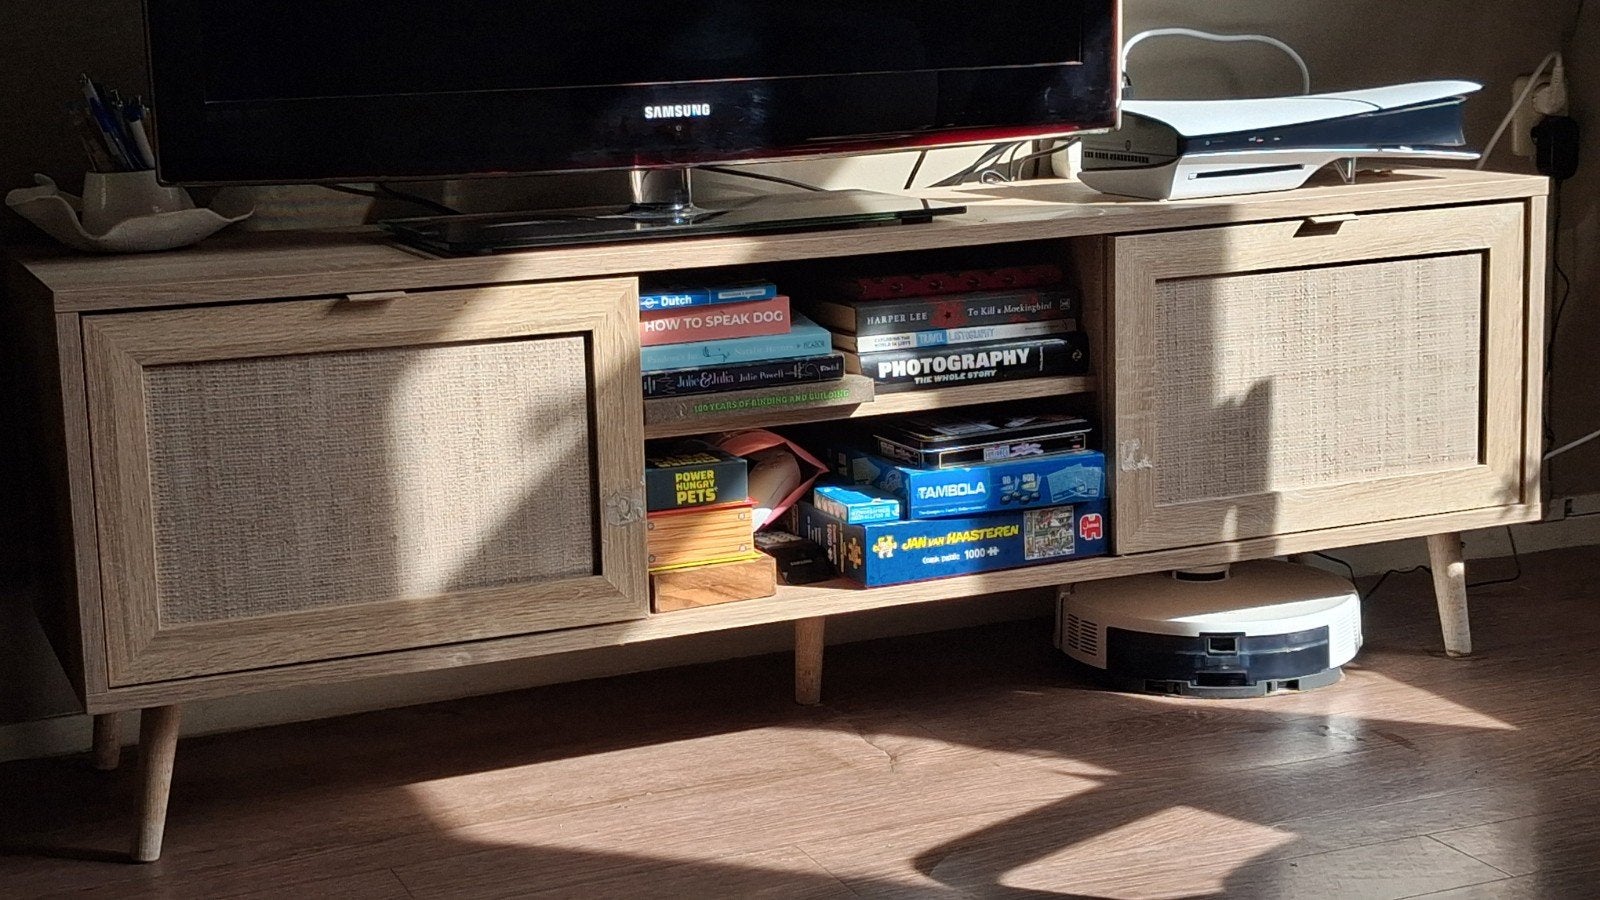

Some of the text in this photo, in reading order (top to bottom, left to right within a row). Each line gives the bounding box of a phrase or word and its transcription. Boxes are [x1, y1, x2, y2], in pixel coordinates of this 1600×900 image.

[644, 103, 711, 119] SAMSUNG
[661, 295, 692, 307] Dutch
[644, 310, 783, 332] HOW TO SPEAK DOG
[866, 314, 906, 325] HARPER
[909, 312, 928, 321] LEE
[967, 307, 979, 317] To
[980, 305, 995, 315] Kill
[1003, 302, 1053, 314] Mockingbird
[919, 331, 945, 344] TRAVEL
[877, 348, 1030, 379] PHOTOGRAPHY
[739, 372, 758, 382] Julie
[759, 368, 784, 380] Powell
[914, 369, 998, 385] THE WHOLE STORY
[694, 404, 709, 413] 100
[710, 402, 737, 411] YEARS
[738, 400, 750, 408] OF
[790, 394, 808, 403] AND
[674, 469, 715, 483] POWER
[675, 479, 716, 491] HUNGRY
[917, 481, 986, 499] TAMBOLA
[676, 487, 717, 505] PETS
[901, 525, 1019, 551] JAN VAN HAASTEREN
[964, 547, 986, 560] 1000
